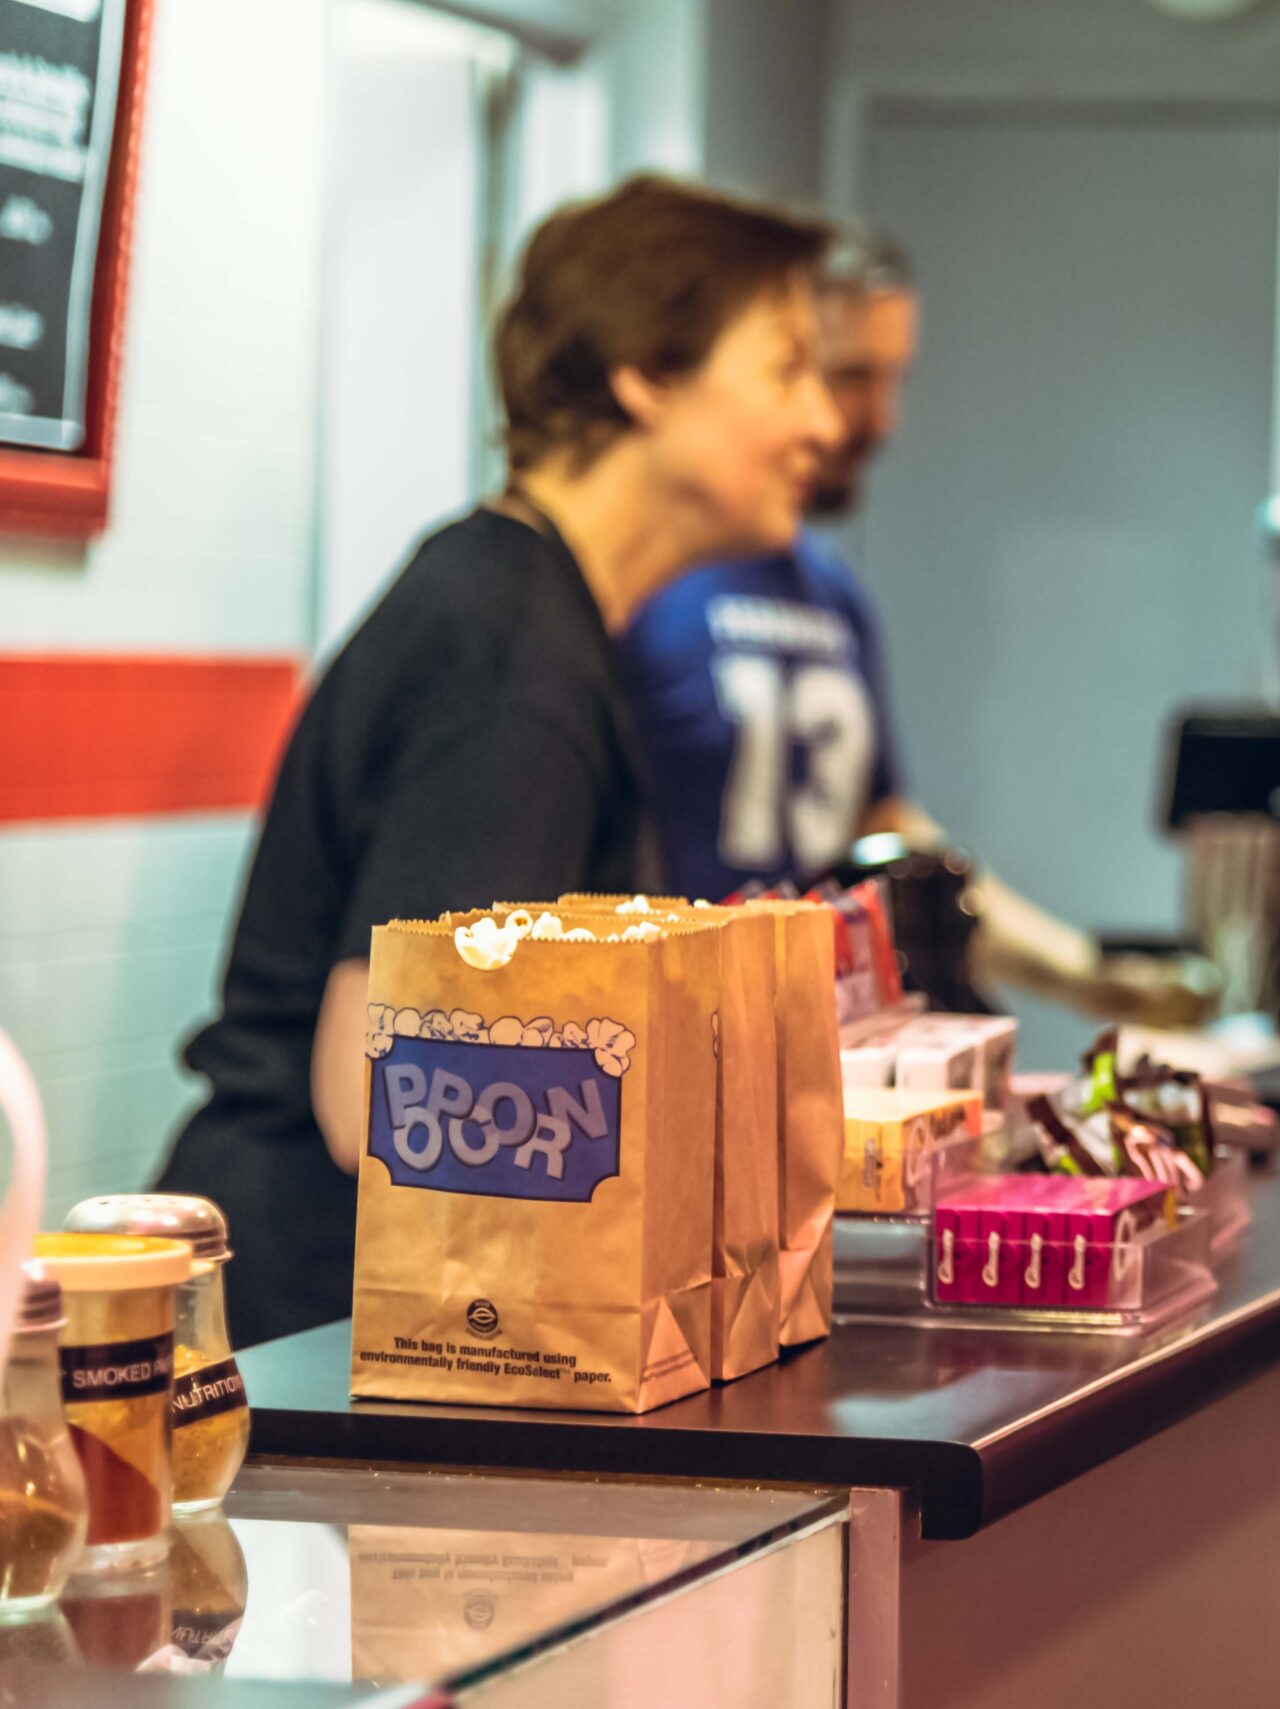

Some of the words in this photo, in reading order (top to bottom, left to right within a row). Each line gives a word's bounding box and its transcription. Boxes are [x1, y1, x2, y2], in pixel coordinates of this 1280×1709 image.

[716, 654, 876, 872] 13
[360, 1351, 453, 1371] environmentally
[456, 1358, 501, 1376] friendly
[574, 1371, 612, 1384] paper.
[394, 1337, 418, 1350] This
[421, 1340, 443, 1355] bag
[446, 1342, 457, 1354] is
[460, 1345, 540, 1362] manufactured
[543, 1353, 577, 1368] using
[73, 1362, 151, 1388] SMOKED
[172, 1374, 243, 1413] NUTRITIO
